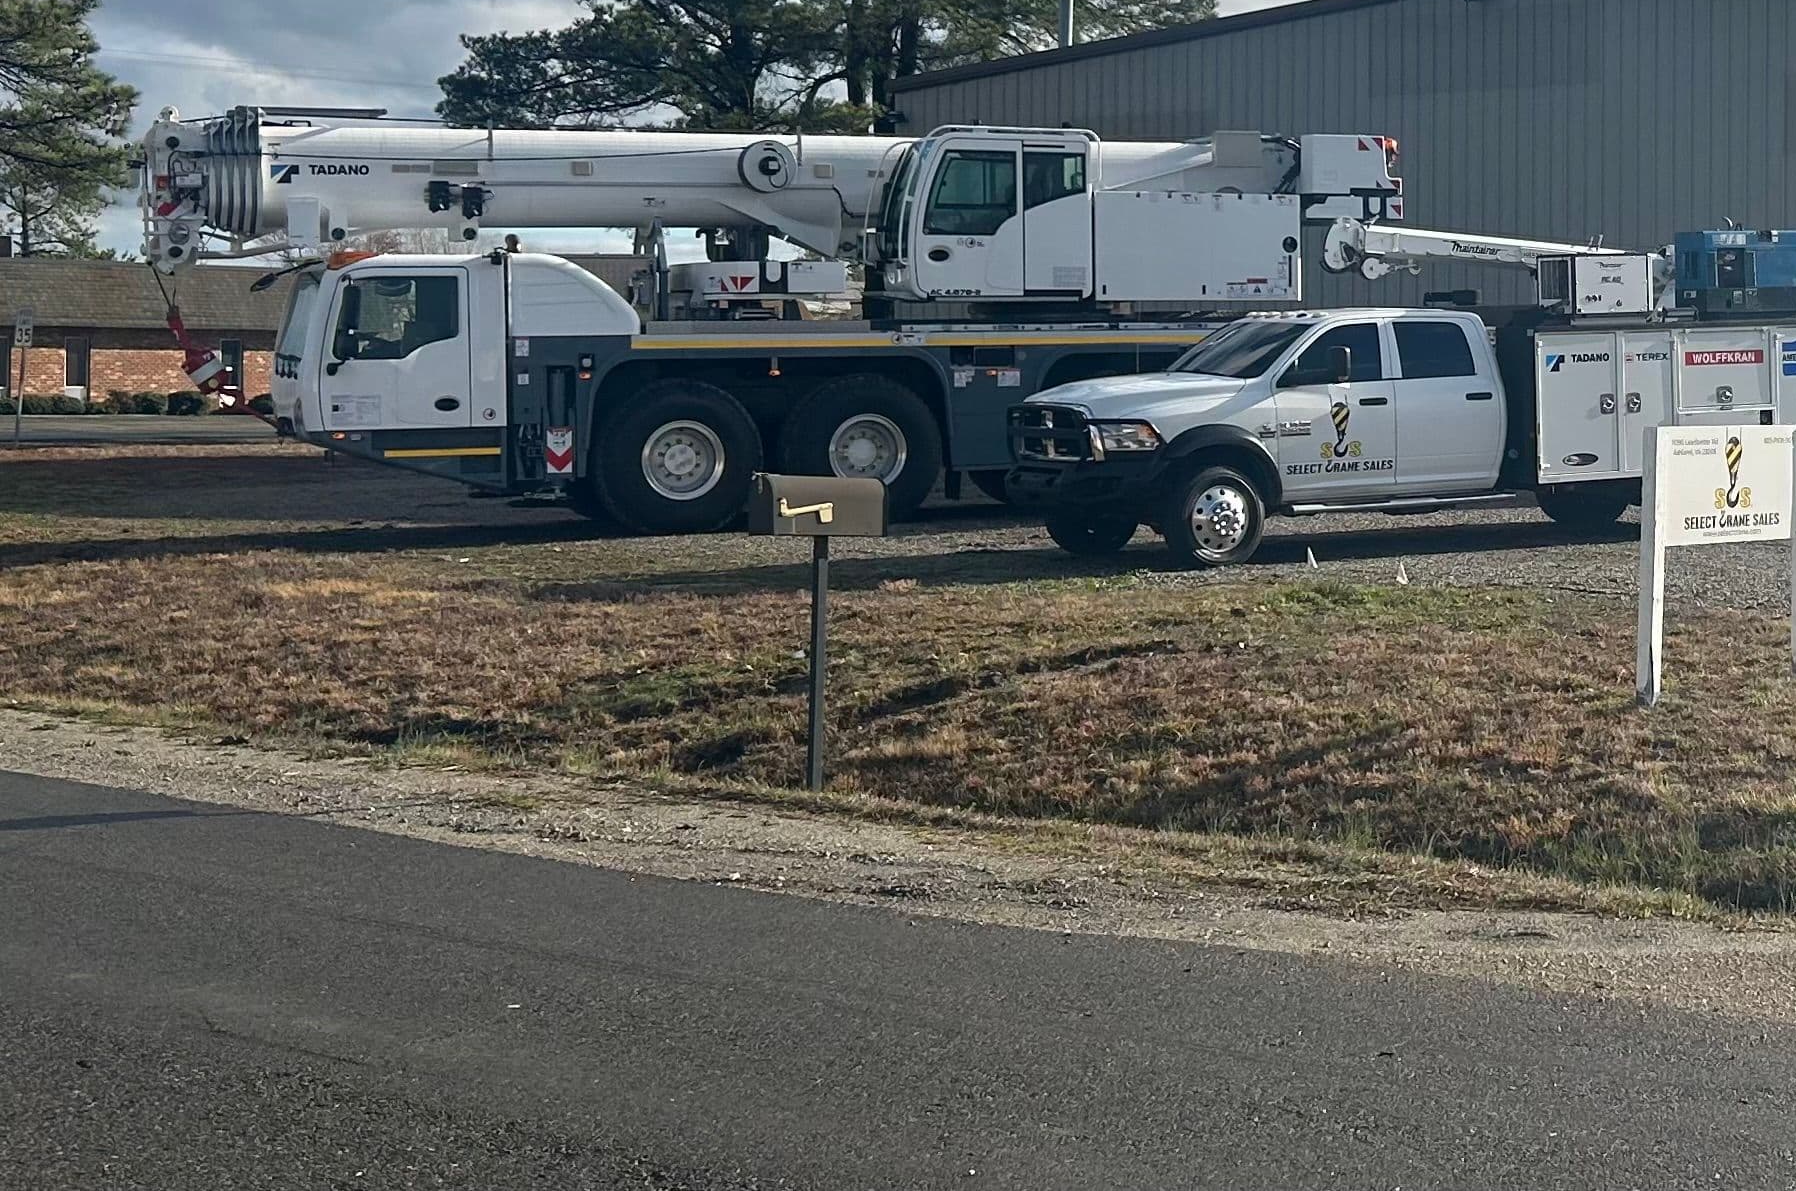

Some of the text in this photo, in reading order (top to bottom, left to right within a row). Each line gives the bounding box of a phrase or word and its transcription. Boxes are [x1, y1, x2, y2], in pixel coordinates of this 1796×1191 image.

[308, 164, 369, 175] TADANO
[1443, 240, 1501, 256] Maintainer
[16, 328, 31, 343] 35
[1571, 353, 1610, 363] TADANO
[1636, 353, 1669, 362] TEREX
[1692, 351, 1755, 364] WOLFFKRAN
[1286, 464, 1322, 475] SELECT
[1363, 460, 1393, 471] SALES
[1684, 516, 1717, 530] SELECT
[1753, 512, 1780, 526] SALES
